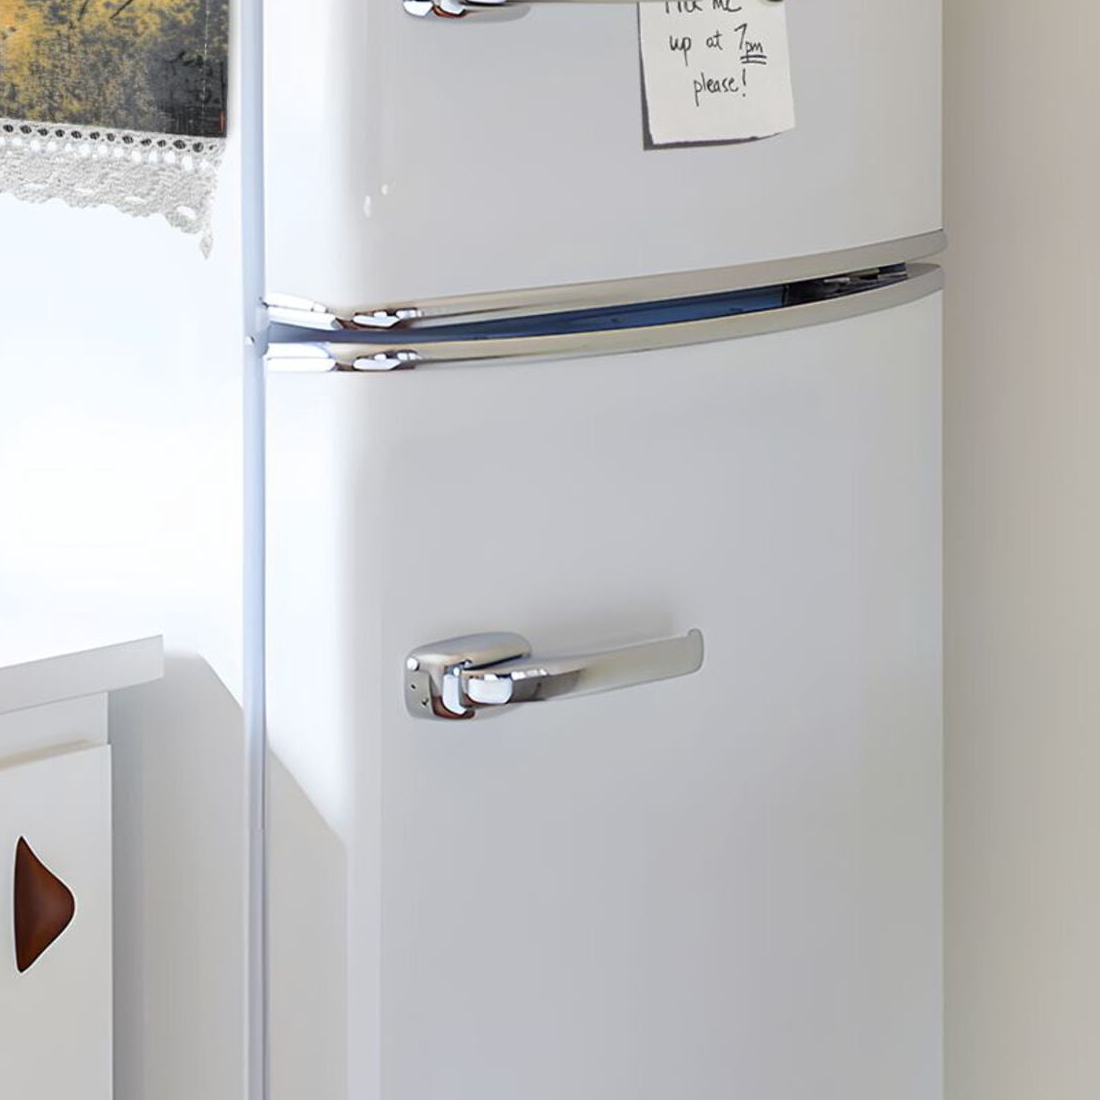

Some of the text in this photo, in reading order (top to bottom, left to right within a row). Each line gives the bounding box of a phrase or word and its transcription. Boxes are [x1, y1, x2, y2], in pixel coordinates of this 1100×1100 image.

[669, 35, 692, 66] up
[706, 30, 723, 50] at
[693, 68, 747, 107] please!
